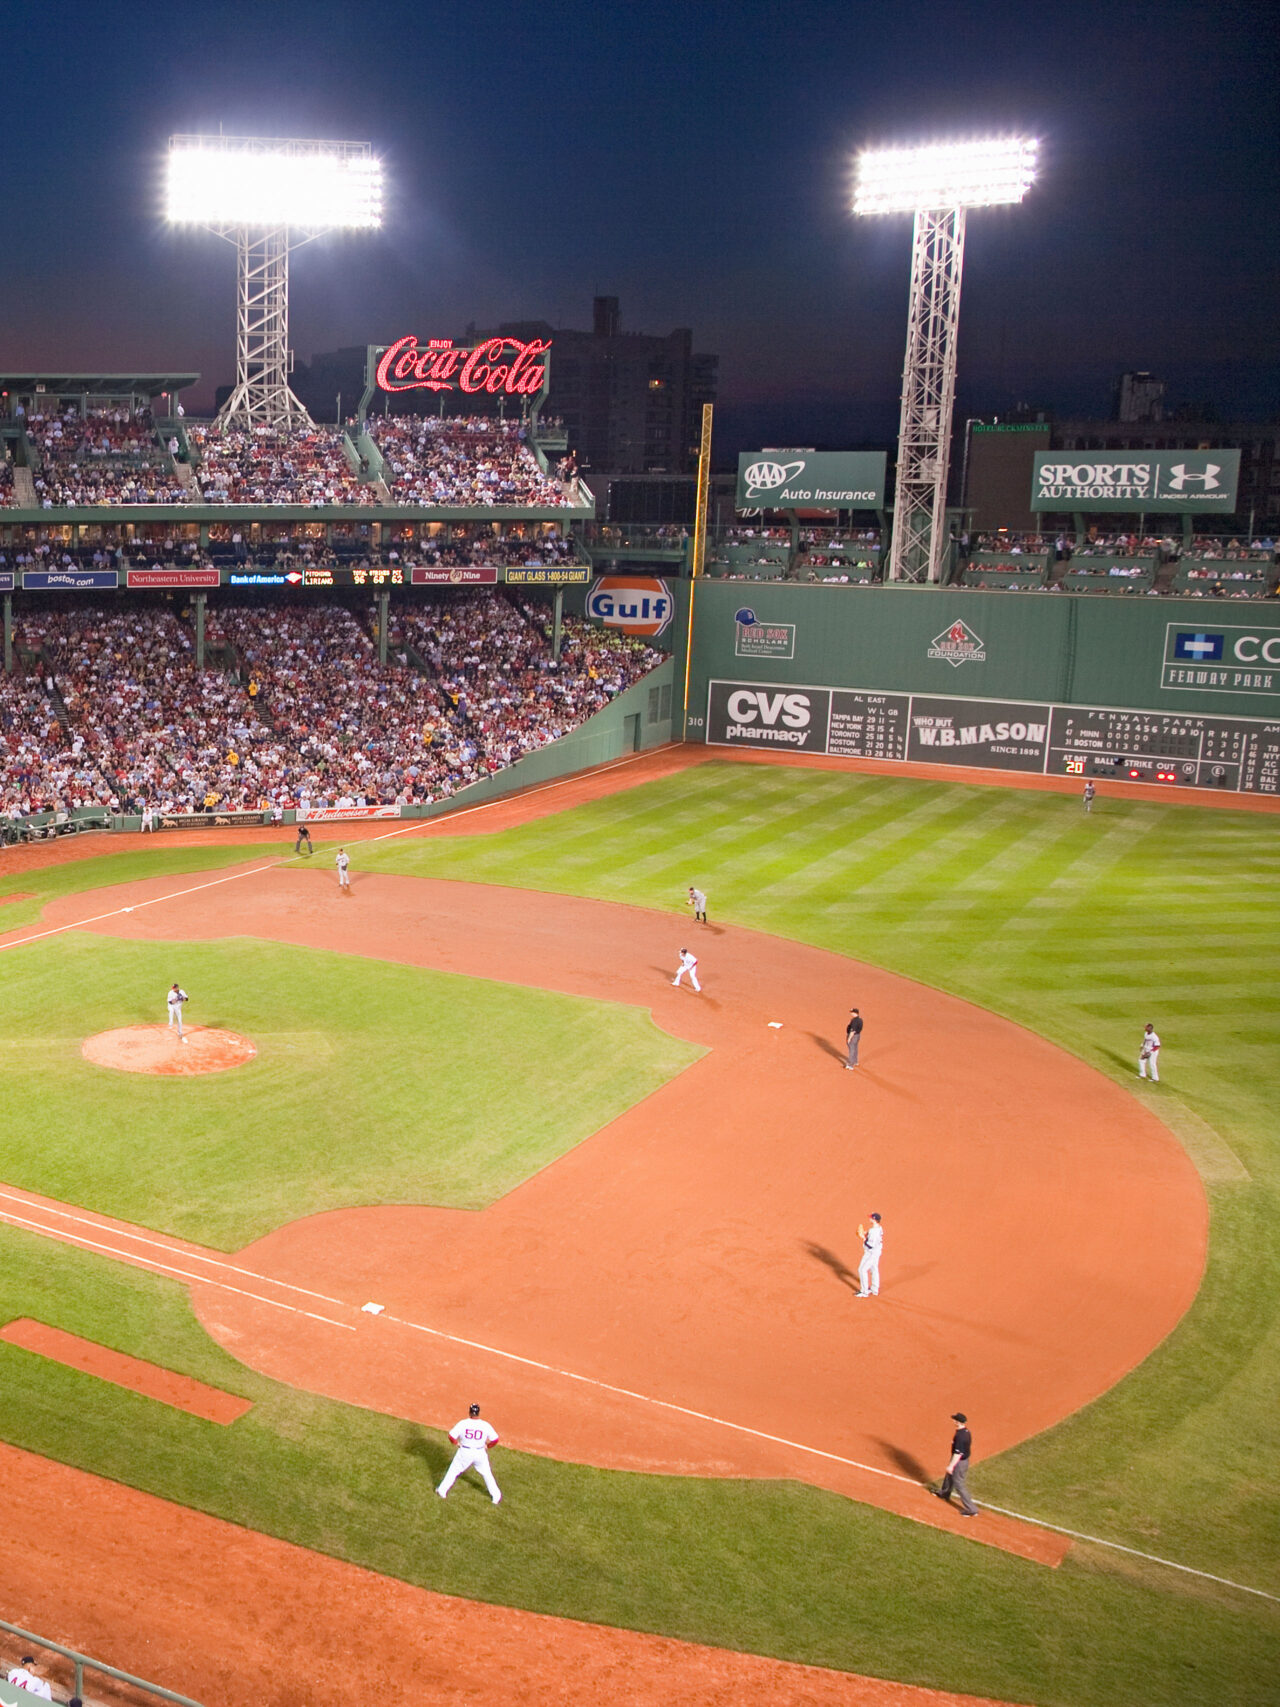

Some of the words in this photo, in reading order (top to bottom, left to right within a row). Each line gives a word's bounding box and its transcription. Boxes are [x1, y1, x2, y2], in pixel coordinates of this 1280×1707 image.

[429, 339, 453, 349] ENJOY
[376, 336, 552, 394] Coca-Cola
[748, 462, 784, 489] AAA
[1039, 464, 1150, 486] SPORTS
[780, 488, 811, 500] Auto
[814, 488, 876, 500] Insurance
[1037, 485, 1149, 499] AUTHORITY
[132, 575, 178, 583] Northeastern
[180, 575, 216, 584] University
[231, 575, 248, 584] Bank
[248, 575, 256, 584] of
[256, 575, 285, 584] America
[305, 577, 333, 585] LIRIANO
[354, 576, 366, 584] 96
[391, 575, 403, 584] 62
[425, 572, 449, 580] Ninety
[463, 571, 480, 579] Nine
[508, 572, 526, 581] GIANT
[527, 572, 546, 581] GLASS
[547, 572, 569, 581] 1-800-54
[569, 571, 586, 581] GIANT
[592, 594, 667, 619] Gulf
[742, 627, 764, 638] RED
[767, 629, 788, 639] SOX
[930, 651, 983, 659] FOUNDATION
[1169, 670, 1228, 685] FENWAY
[1234, 673, 1272, 688] PARK
[727, 690, 811, 728] CVS
[688, 717, 703, 726] 310
[913, 718, 933, 726] WHO
[935, 719, 952, 727] BUT
[1089, 712, 1151, 722] FENWAY
[1162, 718, 1204, 727] PARK
[846, 723, 862, 731] YORK
[726, 724, 808, 745] pharmacy
[831, 730, 860, 738] TORONTO
[919, 722, 1047, 746] W.B.MASON
[1080, 730, 1100, 738] MINN
[1234, 732, 1240, 740] E
[830, 738, 856, 746] BOSTON
[1074, 739, 1103, 748] BOSTON
[829, 746, 861, 755] BALTIMORE
[990, 746, 1017, 754] SINCE
[1020, 748, 1040, 756] 1898
[1263, 752, 1280, 760] NYY
[1066, 761, 1084, 774] 20
[1094, 757, 1115, 765] BALL
[1124, 760, 1153, 769] STRIKE
[1156, 763, 1176, 771] OUT
[315, 808, 369, 819] Budweiser
[465, 1429, 483, 1440] 50
